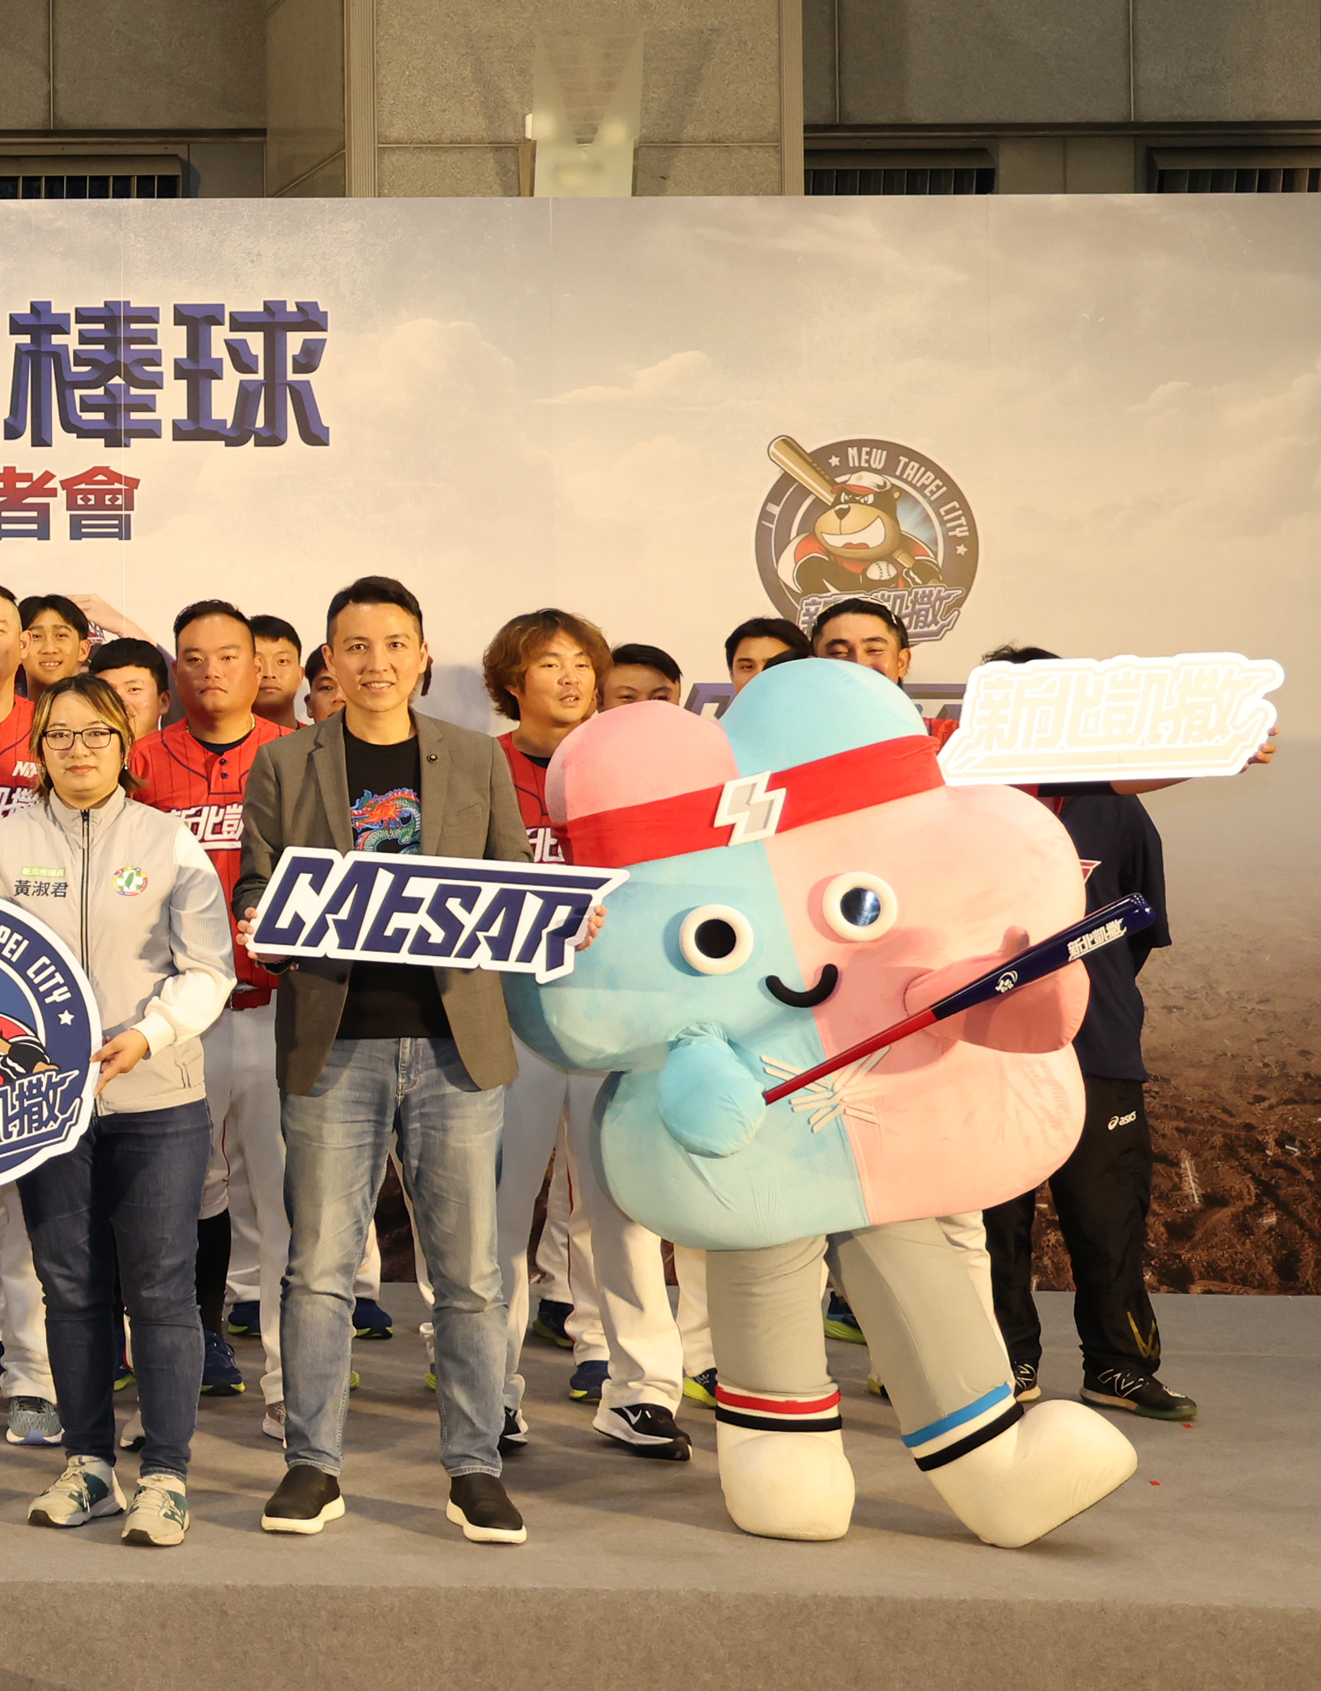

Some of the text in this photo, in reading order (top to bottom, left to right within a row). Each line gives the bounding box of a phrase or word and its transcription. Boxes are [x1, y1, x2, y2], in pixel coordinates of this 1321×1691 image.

[847, 446, 970, 538] NEW TAIPEI CITY
[965, 662, 1279, 762] 新北凱撒
[14, 879, 69, 898] 黃淑君
[254, 856, 613, 973] CAESAR
[26, 955, 72, 1004] CITY
